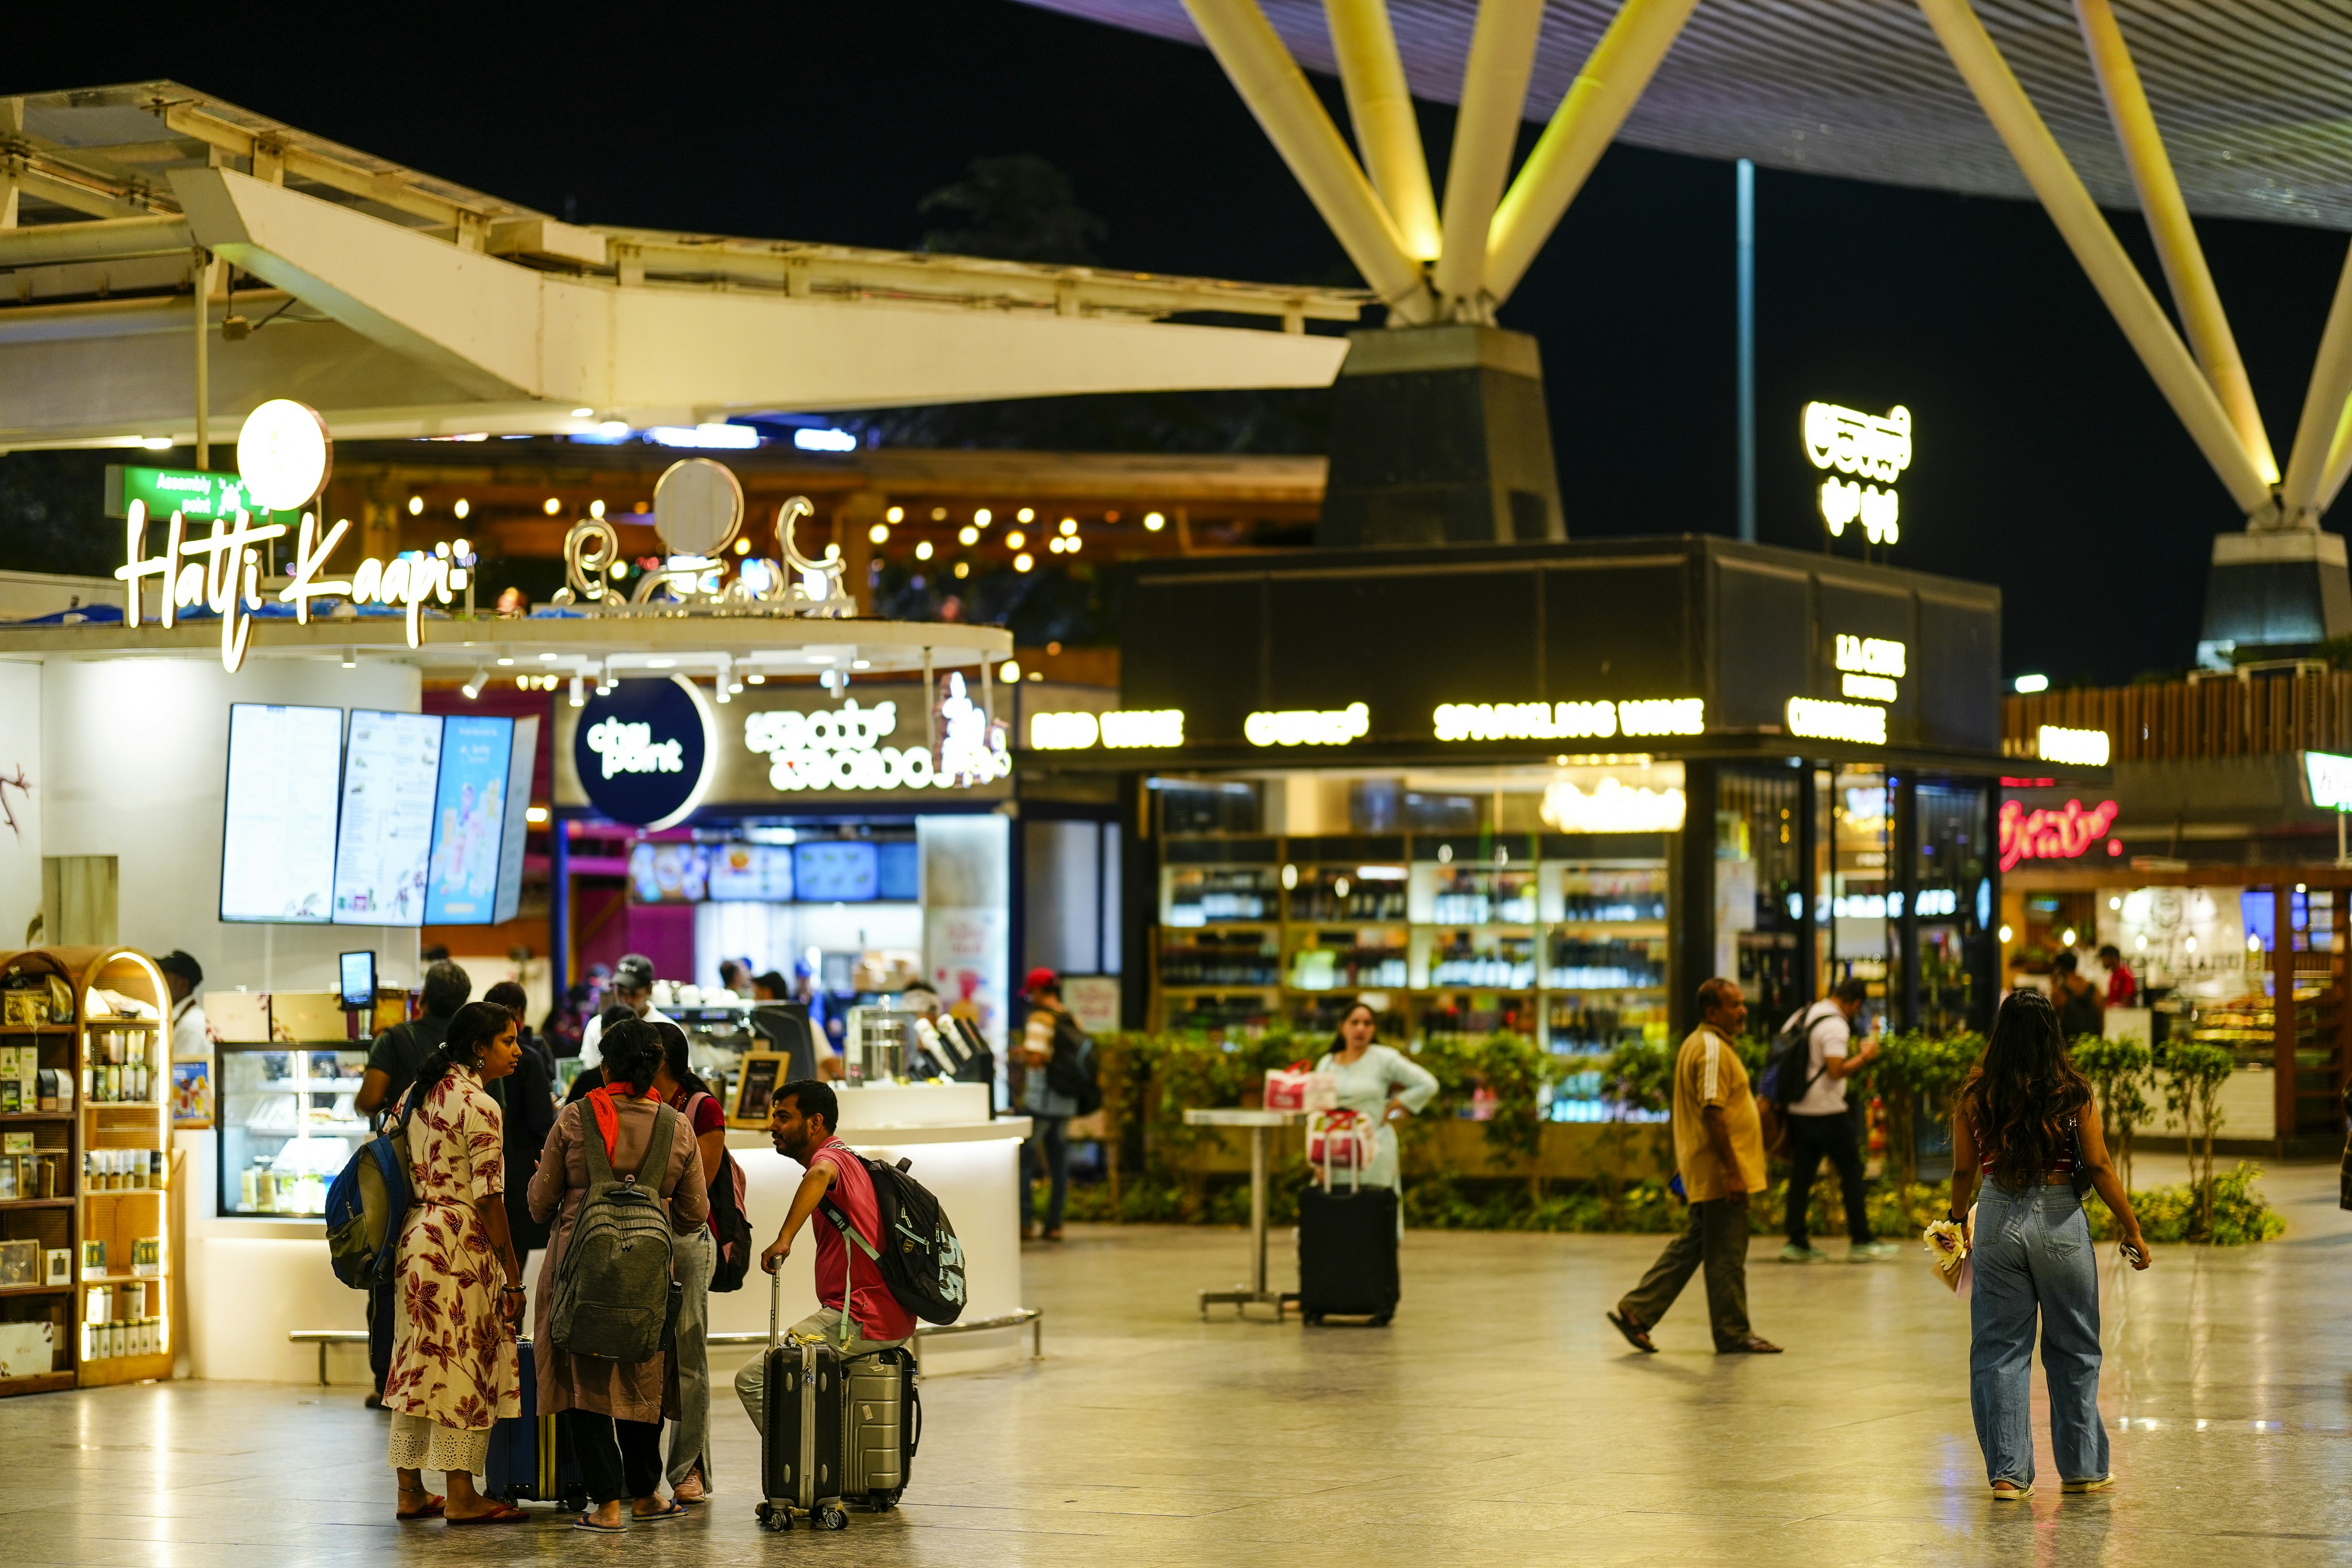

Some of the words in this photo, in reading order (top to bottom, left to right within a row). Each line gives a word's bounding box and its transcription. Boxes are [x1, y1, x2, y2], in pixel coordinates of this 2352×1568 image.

[156, 473, 211, 495] Assembly
[182, 497, 211, 514] point
[115, 499, 288, 673] Hatti
[602, 740, 682, 779] point
